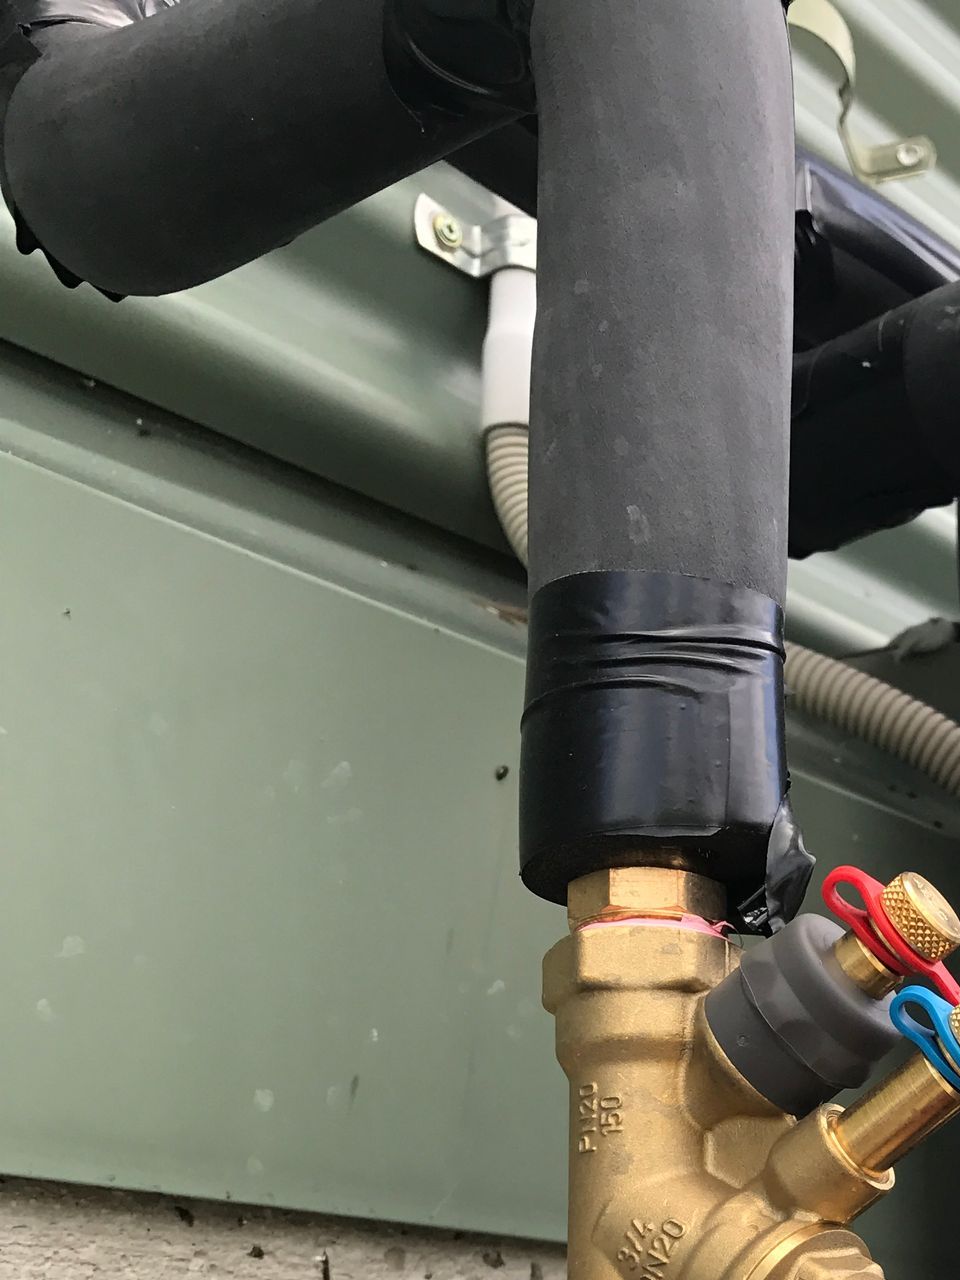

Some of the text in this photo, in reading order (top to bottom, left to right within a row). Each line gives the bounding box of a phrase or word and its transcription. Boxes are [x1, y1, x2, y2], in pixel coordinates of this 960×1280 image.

[578, 1081, 598, 1154] PN20
[600, 1095, 625, 1137] 150
[617, 1217, 655, 1272] 3/4
